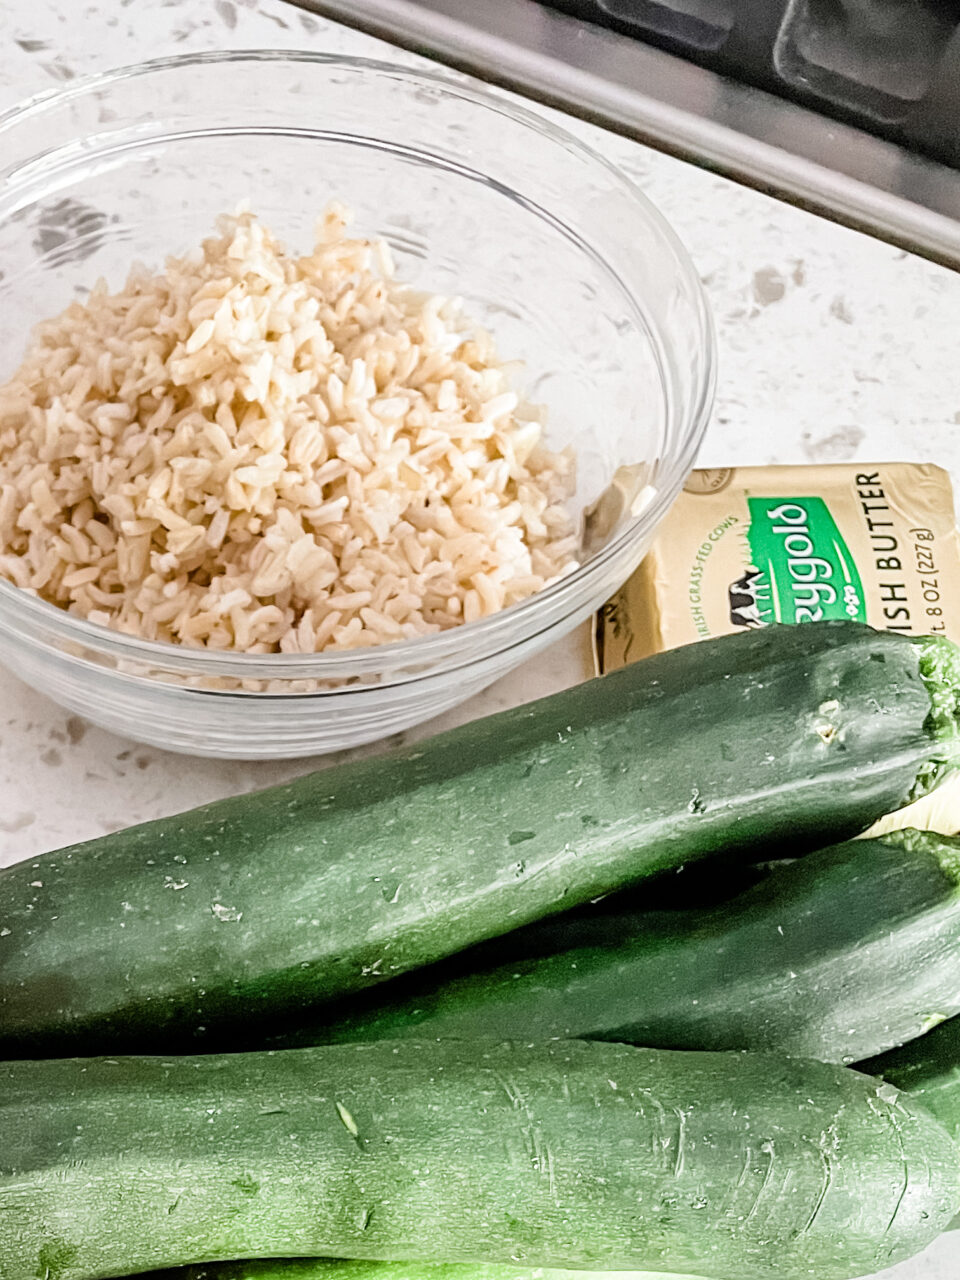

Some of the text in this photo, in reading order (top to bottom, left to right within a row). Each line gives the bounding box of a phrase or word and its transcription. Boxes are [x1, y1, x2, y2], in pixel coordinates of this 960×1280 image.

[708, 516, 739, 541] COWS
[855, 472, 902, 570] BUTTER
[689, 542, 713, 603] GRASS-FED
[921, 578, 940, 602] OZ
[690, 606, 711, 637] IRISH
[925, 607, 943, 616] 8
